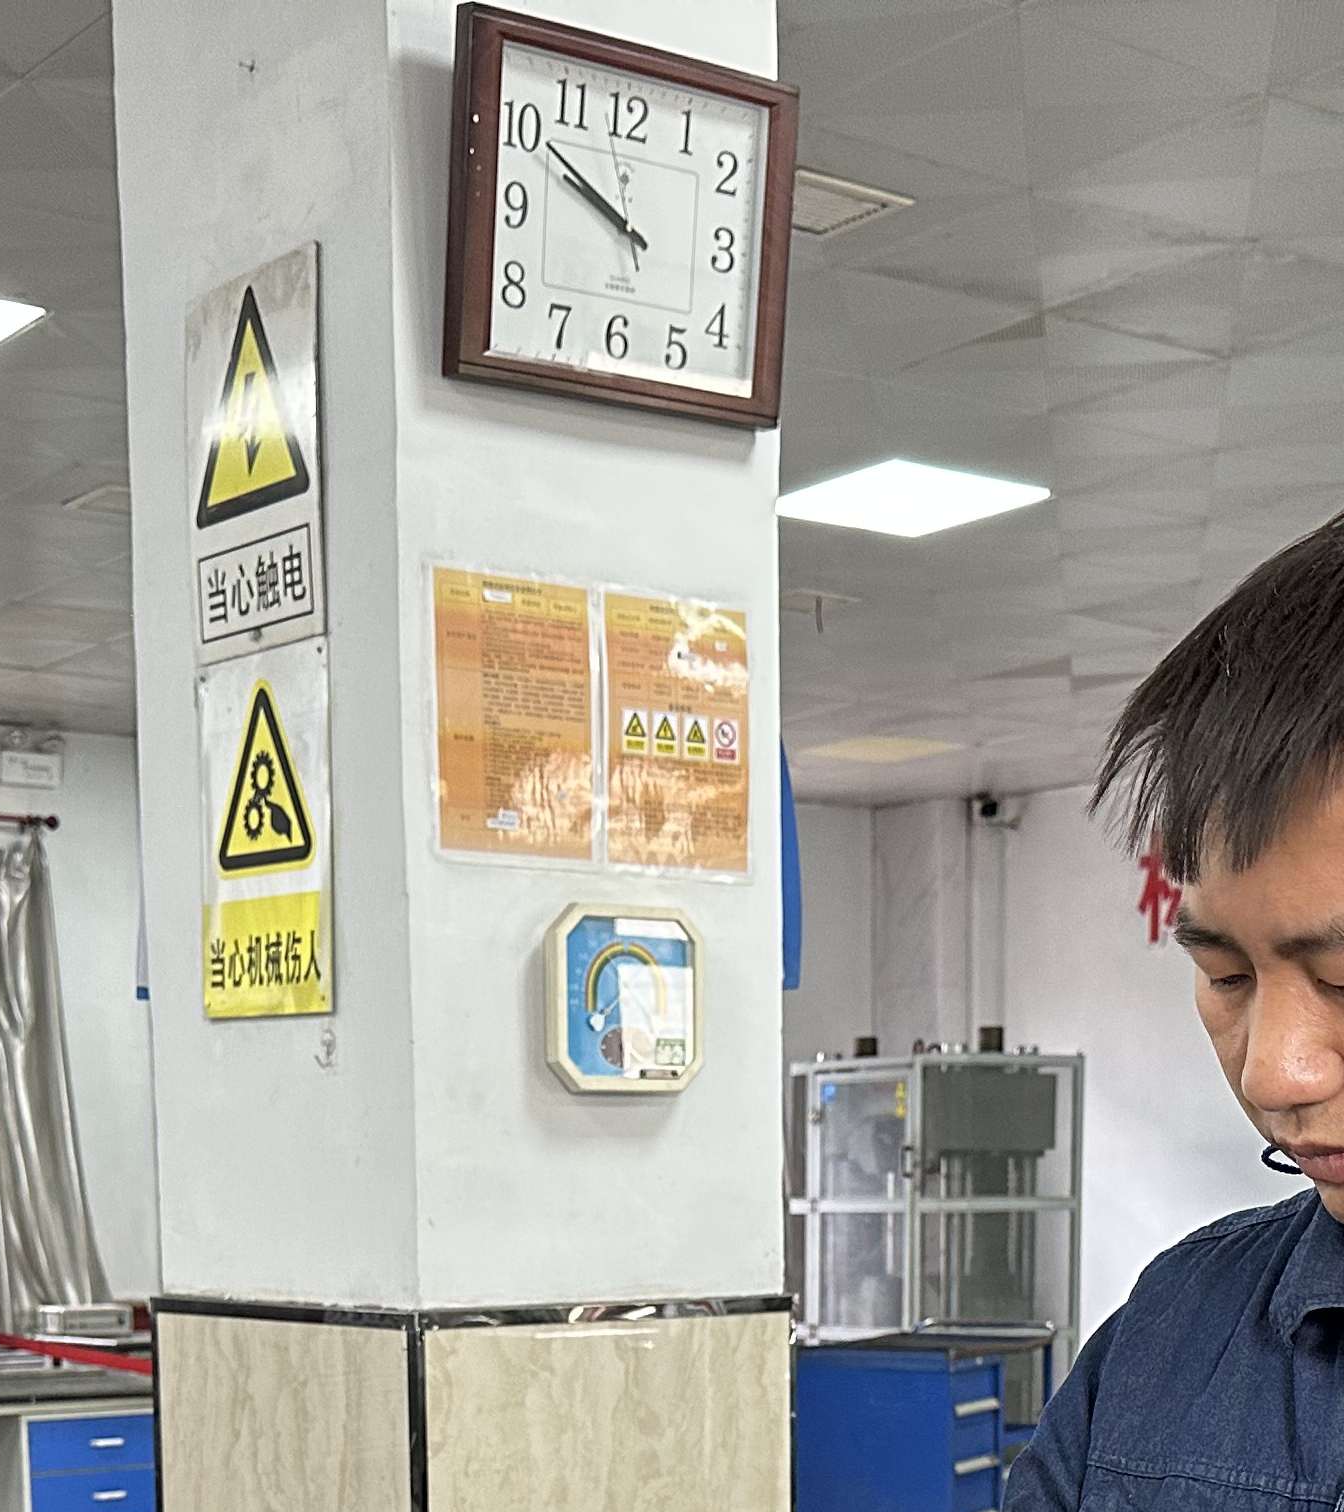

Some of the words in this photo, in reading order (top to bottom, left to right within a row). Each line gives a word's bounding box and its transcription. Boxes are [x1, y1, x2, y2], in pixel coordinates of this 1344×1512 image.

[502, 100, 542, 153] 10
[554, 78, 589, 131] 11
[608, 91, 649, 145] 12
[679, 109, 694, 156] 1
[715, 150, 739, 197] 2
[503, 181, 529, 229] 9
[710, 227, 735, 274] 3
[501, 260, 526, 309] 8
[547, 302, 572, 350] 7
[604, 314, 630, 360] 6
[664, 323, 688, 370] 5
[704, 302, 729, 350] 4
[208, 544, 307, 624] 当心触电
[211, 929, 322, 990] 当心机械伤人
